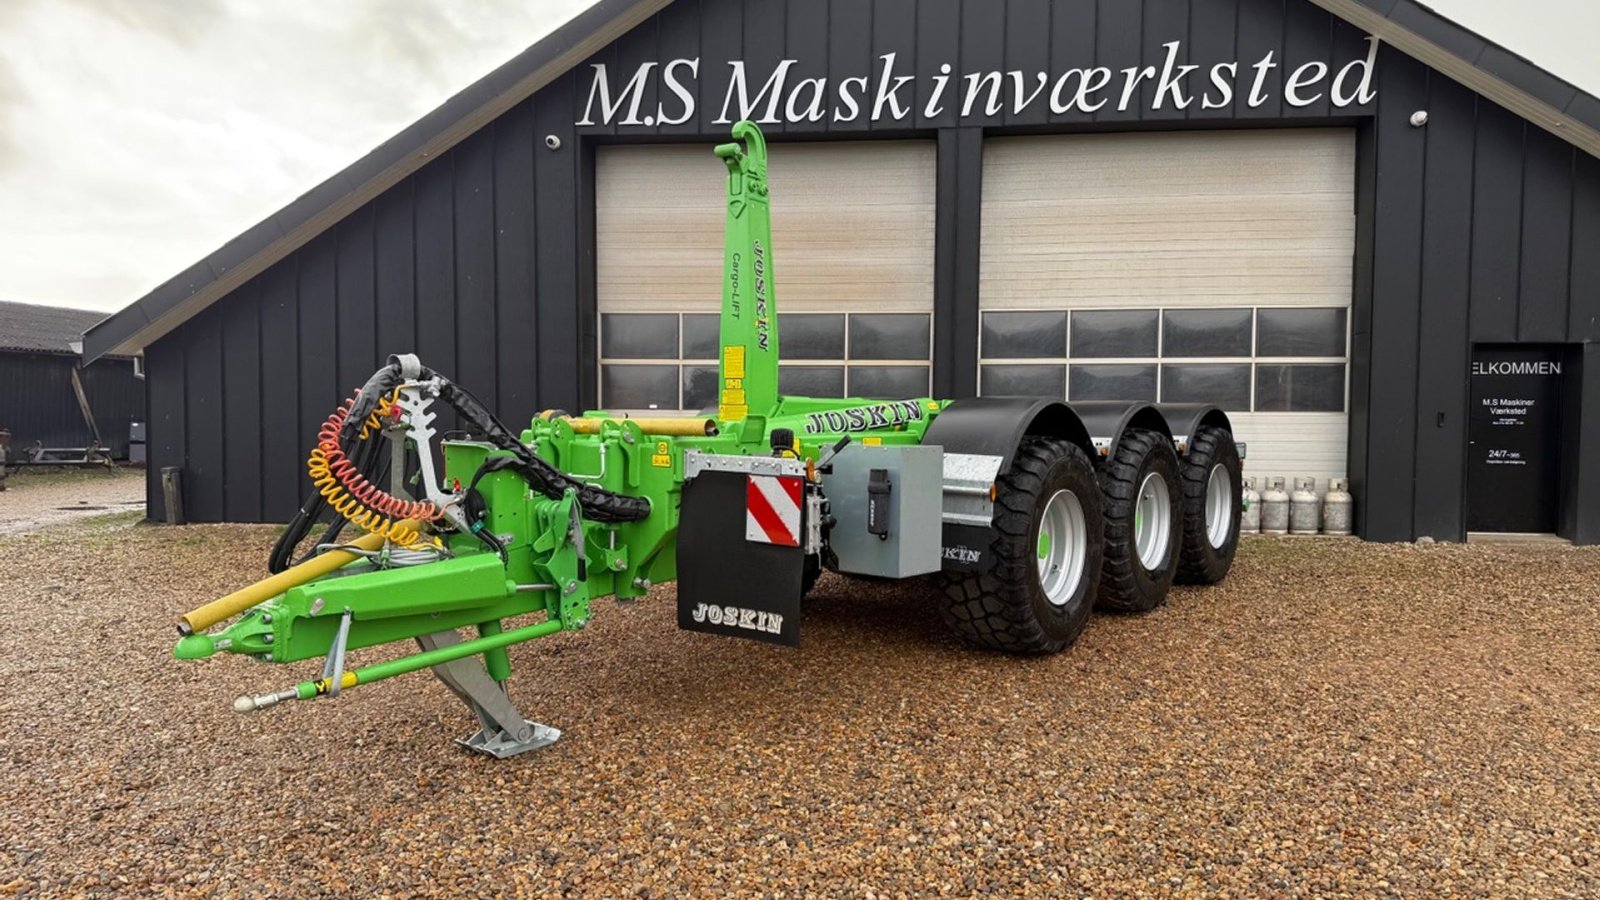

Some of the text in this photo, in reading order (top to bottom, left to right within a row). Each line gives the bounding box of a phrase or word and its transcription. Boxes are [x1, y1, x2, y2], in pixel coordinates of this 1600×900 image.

[575, 36, 1381, 126] M.S Maskinværksted
[731, 252, 741, 320] Cargo-LIFT
[754, 239, 769, 352] JOSKIN
[806, 399, 922, 433] JOSKIN
[692, 602, 784, 634] JOSKIN
